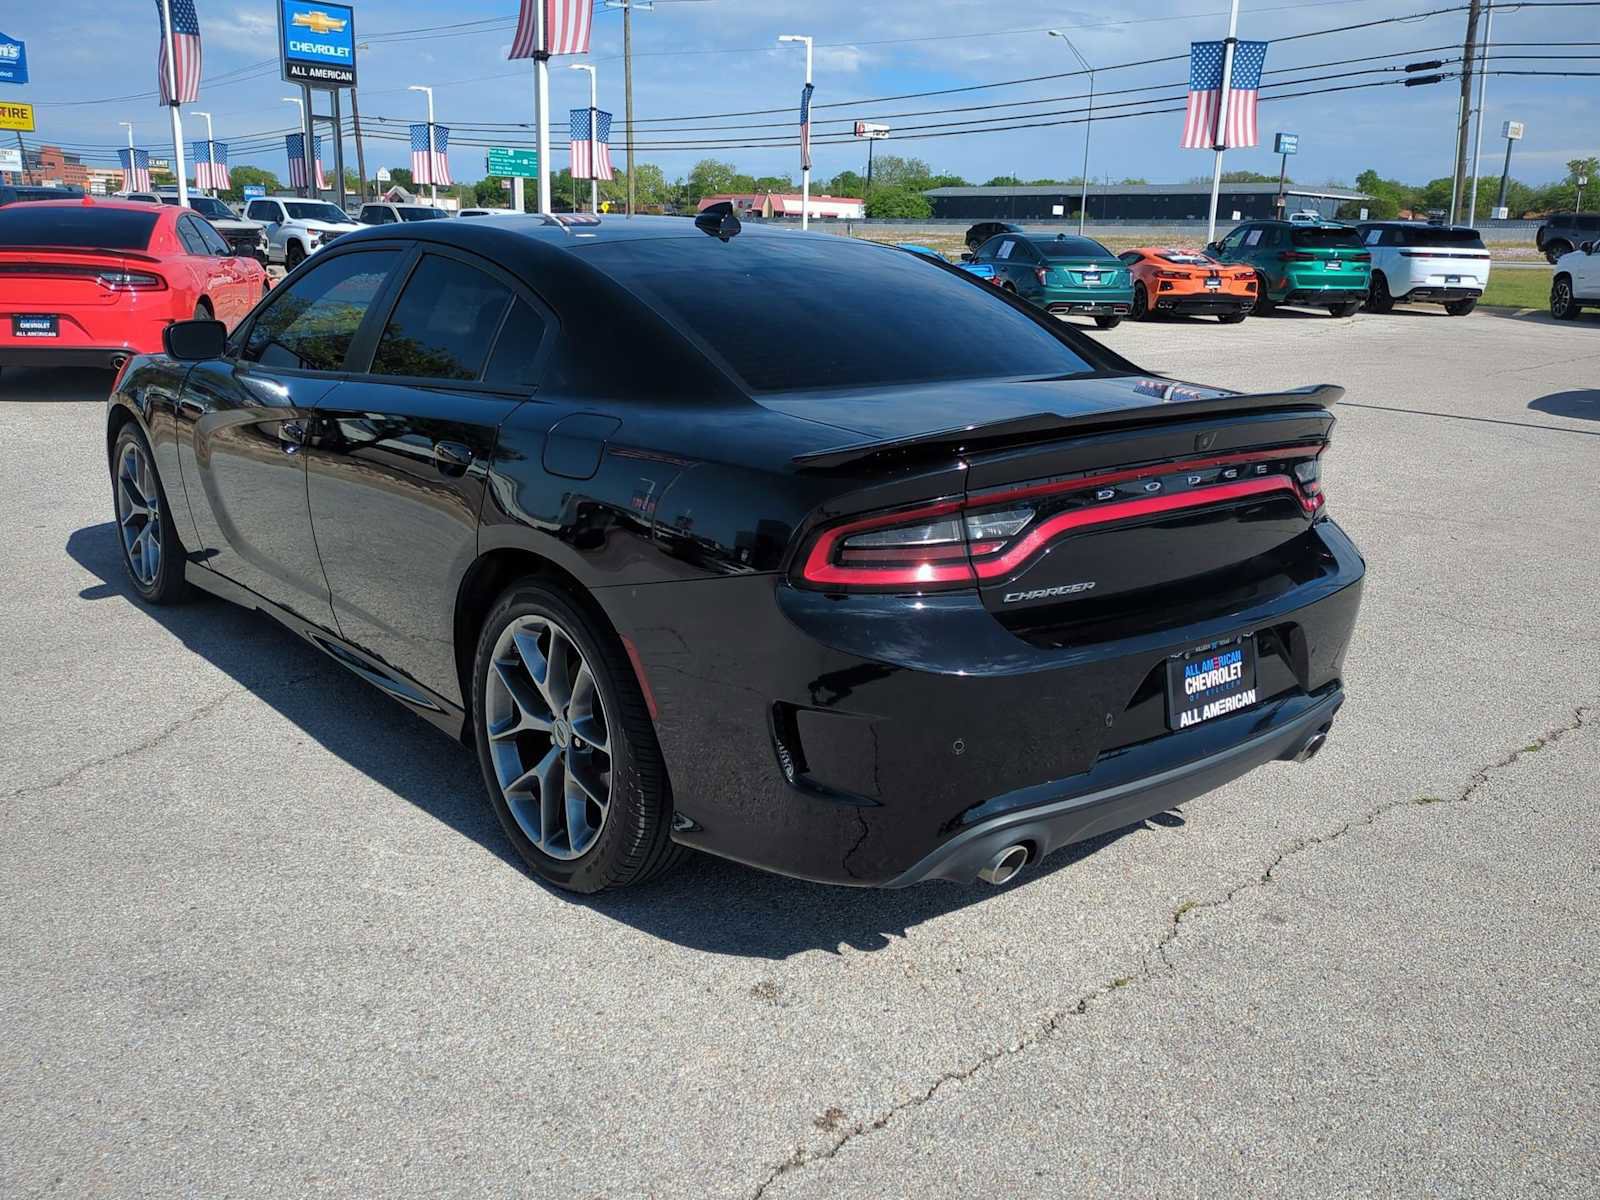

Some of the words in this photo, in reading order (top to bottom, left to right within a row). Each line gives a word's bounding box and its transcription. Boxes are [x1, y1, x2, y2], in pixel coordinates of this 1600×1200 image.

[289, 40, 350, 57] CHEVROLET
[291, 65, 308, 76] ALL
[309, 67, 353, 81] AMERICAN
[1096, 464, 1268, 500] DODGE
[1004, 581, 1096, 604] CHARGER
[1185, 663, 1201, 677] ALL
[1202, 649, 1242, 673] AMERICAN
[1185, 661, 1243, 695] CHEVROLET
[1180, 708, 1202, 728] ALL
[1203, 689, 1256, 720] AMERICAN
